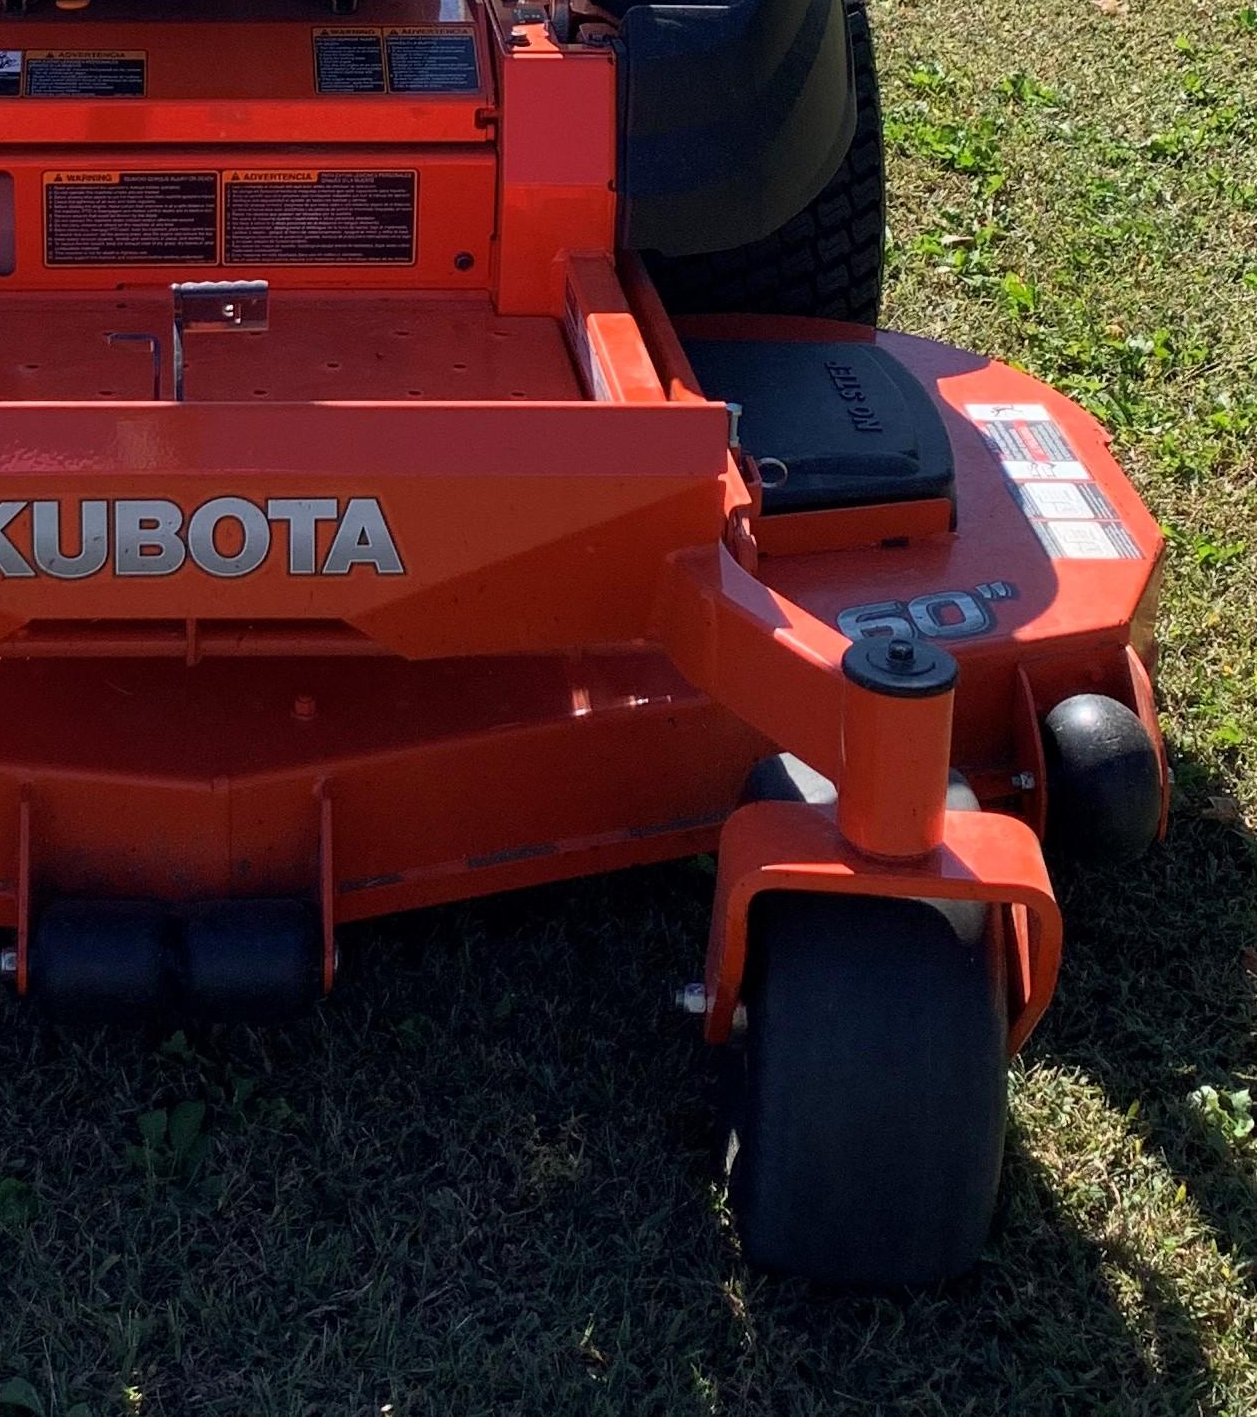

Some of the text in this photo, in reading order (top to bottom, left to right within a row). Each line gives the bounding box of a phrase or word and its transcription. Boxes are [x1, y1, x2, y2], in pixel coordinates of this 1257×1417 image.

[66, 174, 113, 182] WARNING
[243, 172, 313, 181] ADVERTENCIA
[847, 406, 883, 432] NO
